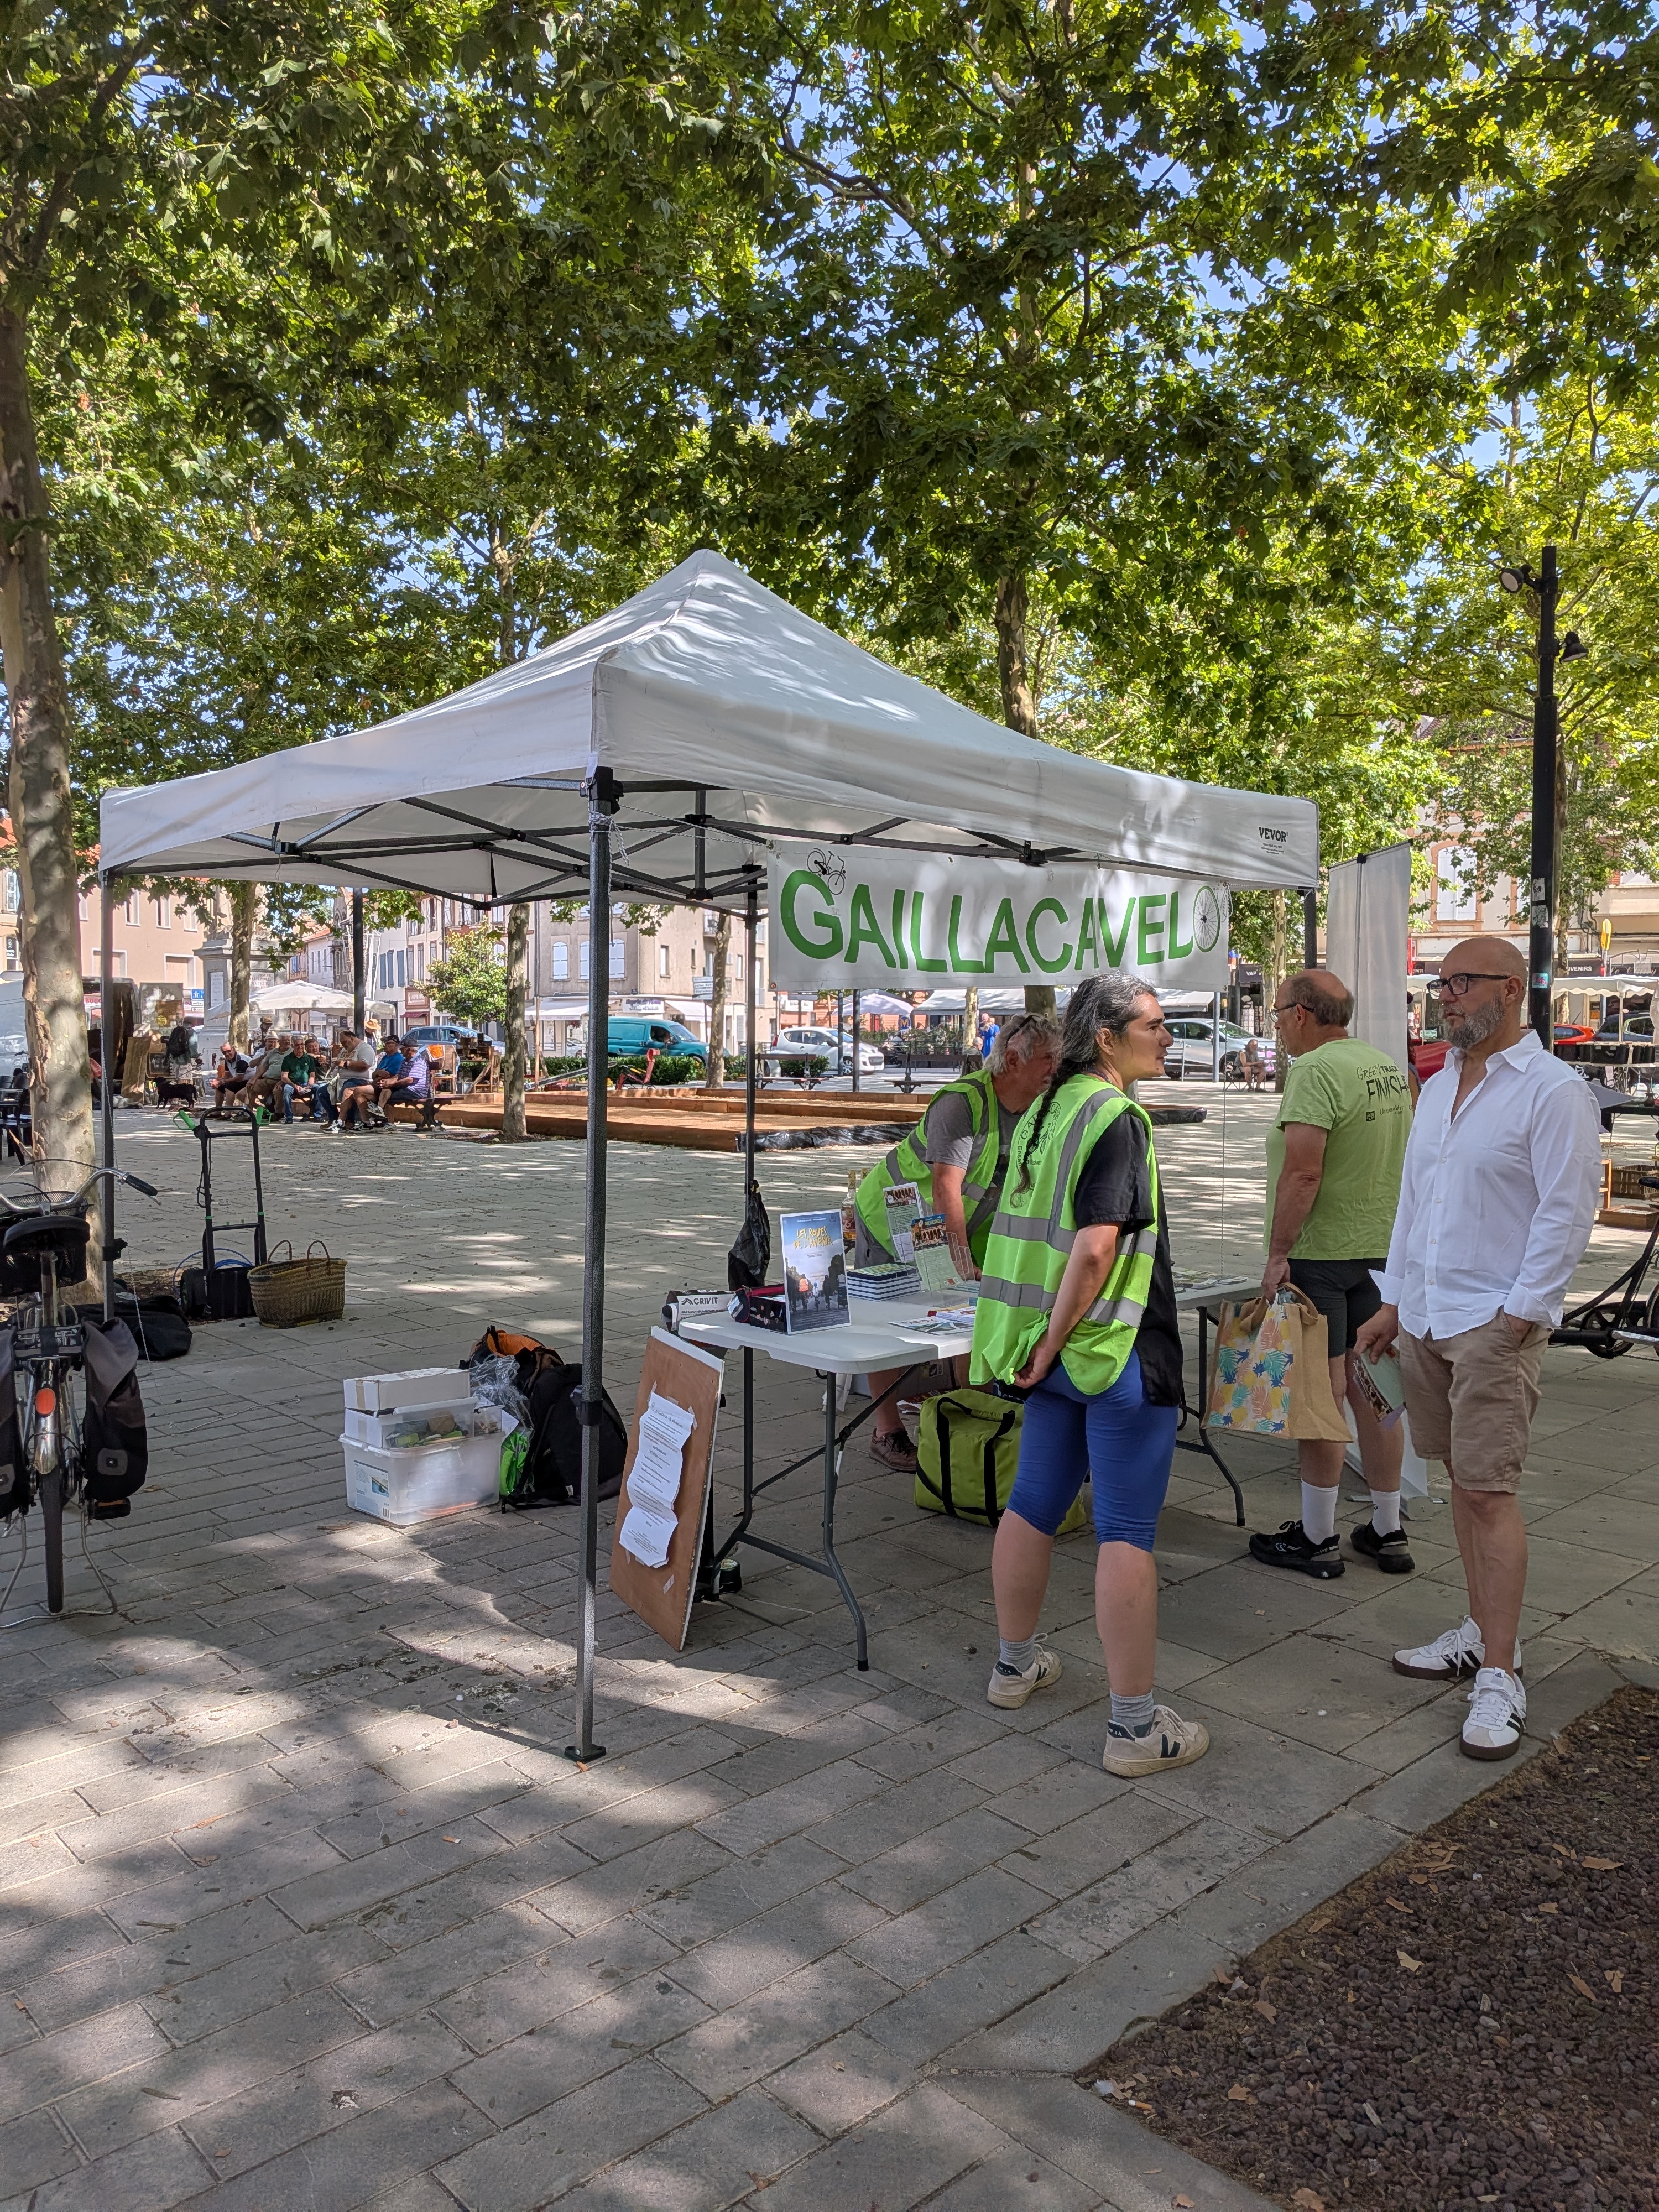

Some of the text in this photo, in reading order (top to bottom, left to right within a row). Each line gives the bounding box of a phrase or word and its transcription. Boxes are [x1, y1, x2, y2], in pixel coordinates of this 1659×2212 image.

[1259, 826, 1287, 843] VEVOR
[1357, 1063, 1381, 1081] GREEN
[693, 1297, 718, 1305] CRIVIT
